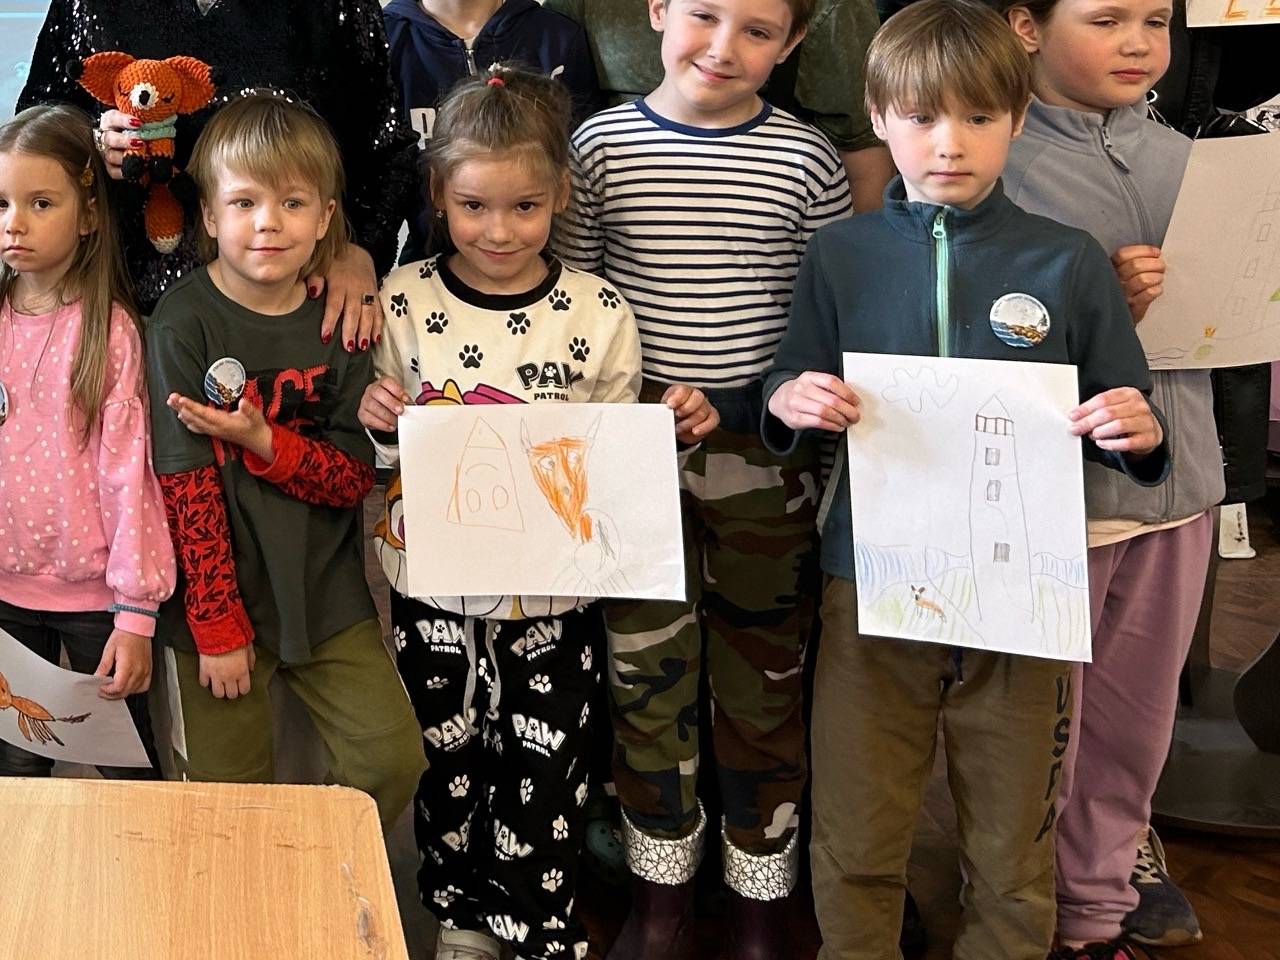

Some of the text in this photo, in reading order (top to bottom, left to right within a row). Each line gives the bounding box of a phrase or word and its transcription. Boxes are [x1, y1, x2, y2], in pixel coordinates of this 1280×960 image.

[534, 392, 569, 401] PATROL
[510, 619, 563, 656] PAW
[431, 645, 461, 654] PATROL
[526, 644, 556, 661] PATROL
[512, 713, 566, 751] PAW
[522, 740, 551, 757] PATROL
